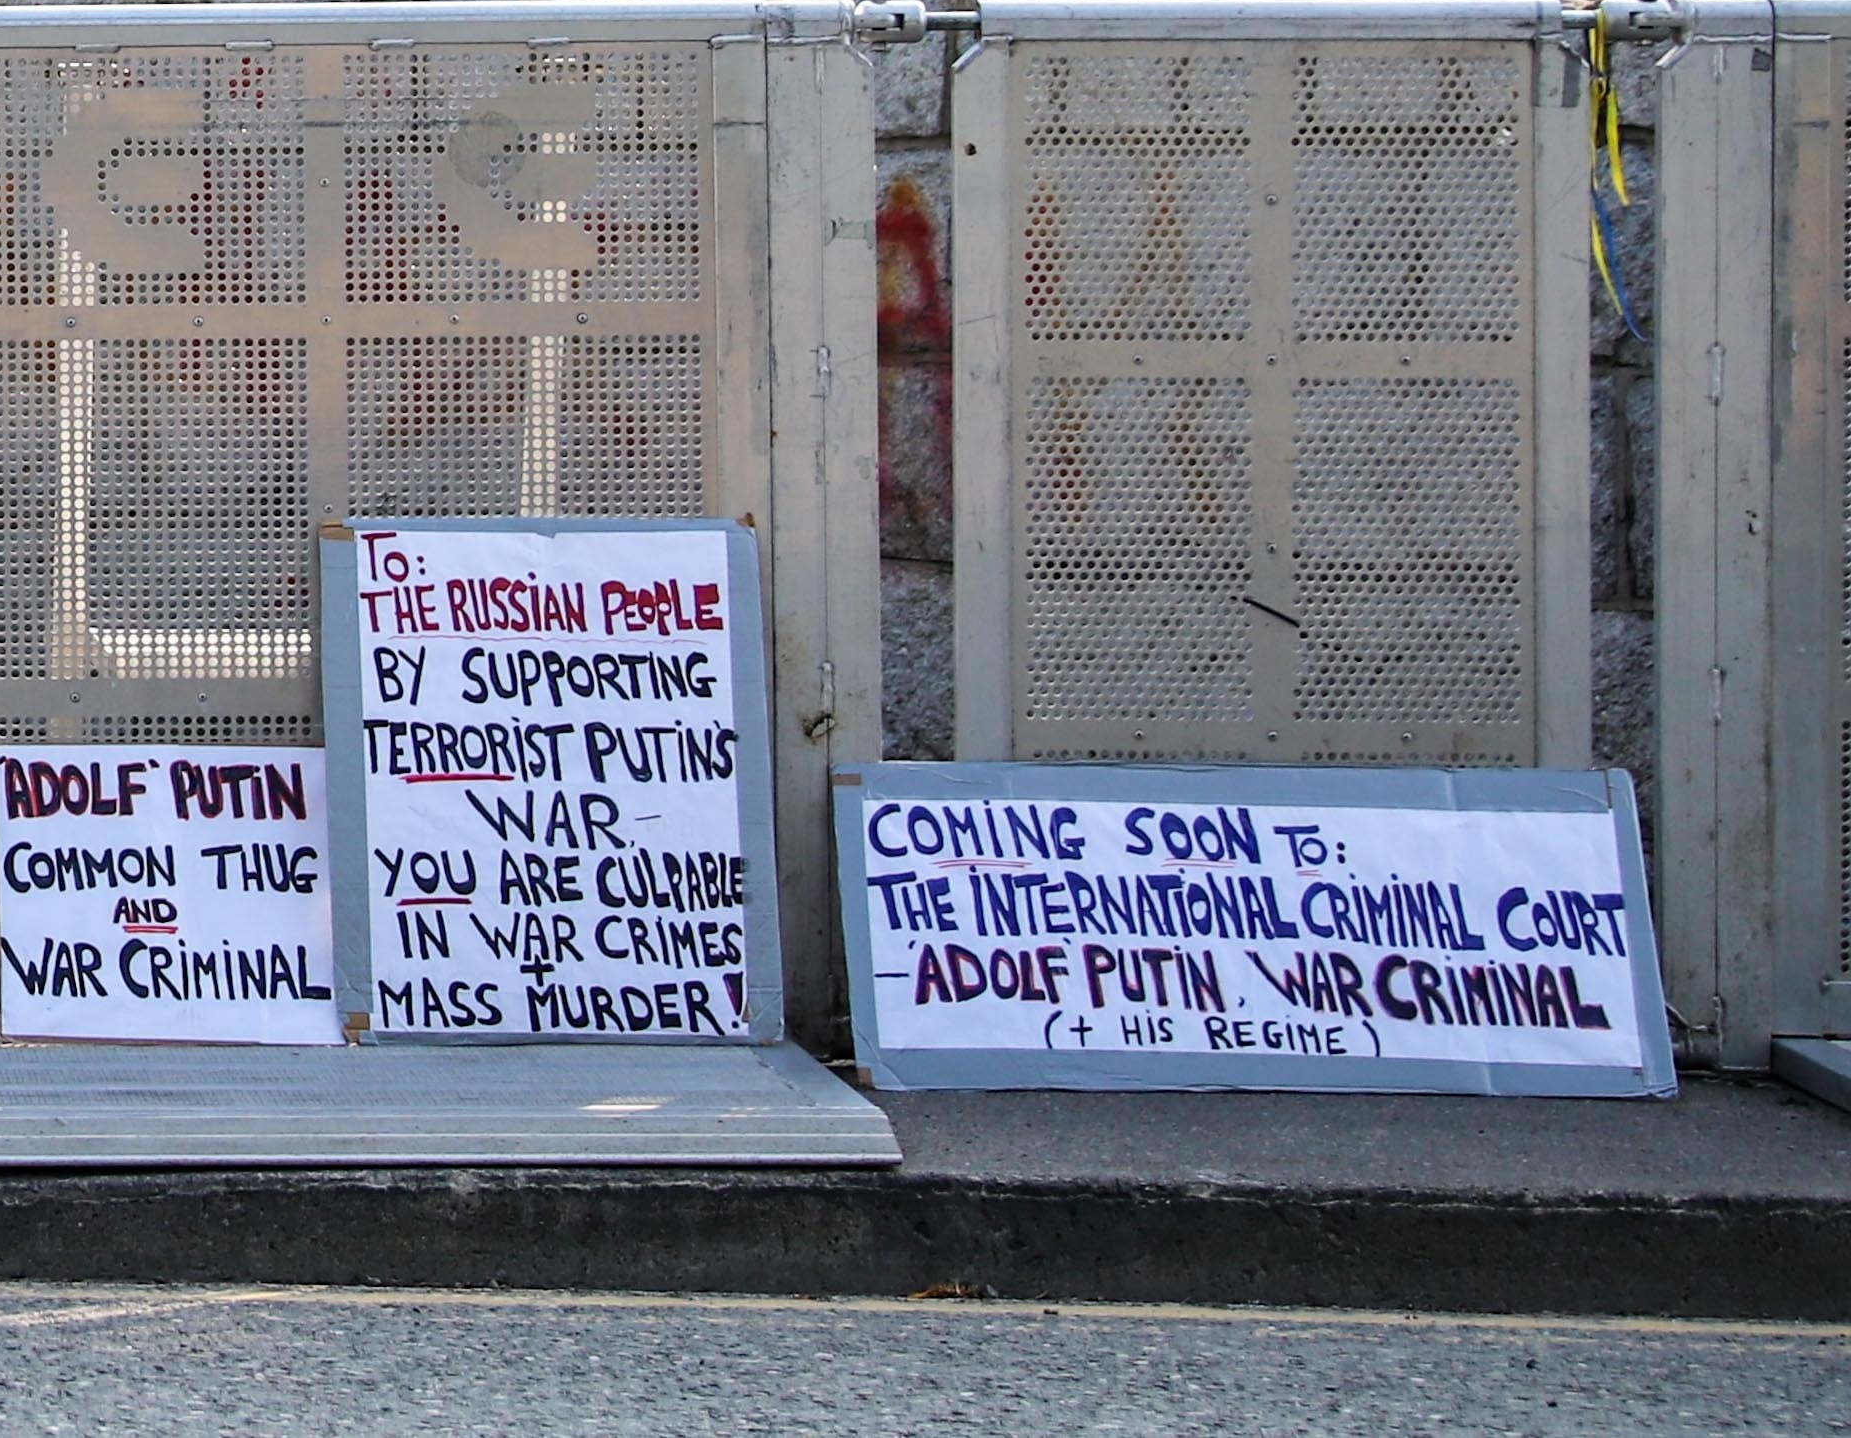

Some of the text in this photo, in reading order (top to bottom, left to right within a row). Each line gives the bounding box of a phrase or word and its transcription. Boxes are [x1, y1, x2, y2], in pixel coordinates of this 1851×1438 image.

[361, 573, 723, 634] THE RUSSIAN PEOPLE
[373, 647, 716, 706] BY SUPPORTING
[364, 717, 574, 782] TERRORIST
[173, 759, 307, 820] PUTIN
[868, 800, 1085, 860] COMING
[1126, 805, 1259, 864] SOON
[4, 842, 318, 892] COMMON THUG
[374, 849, 746, 912] YOU ARE CULPABLE
[113, 898, 177, 923] AND
[397, 912, 742, 968] IN WAR CRIMES
[868, 866, 1624, 956] THE INTERNATIONAL CRIMINAL COURT
[0, 938, 331, 1000] WAR CRIMINAL
[1246, 952, 1373, 1018] WAR
[1373, 954, 1608, 1028] CRIMINAL
[379, 980, 501, 1028] MASS
[1123, 1016, 1174, 1045] HIS
